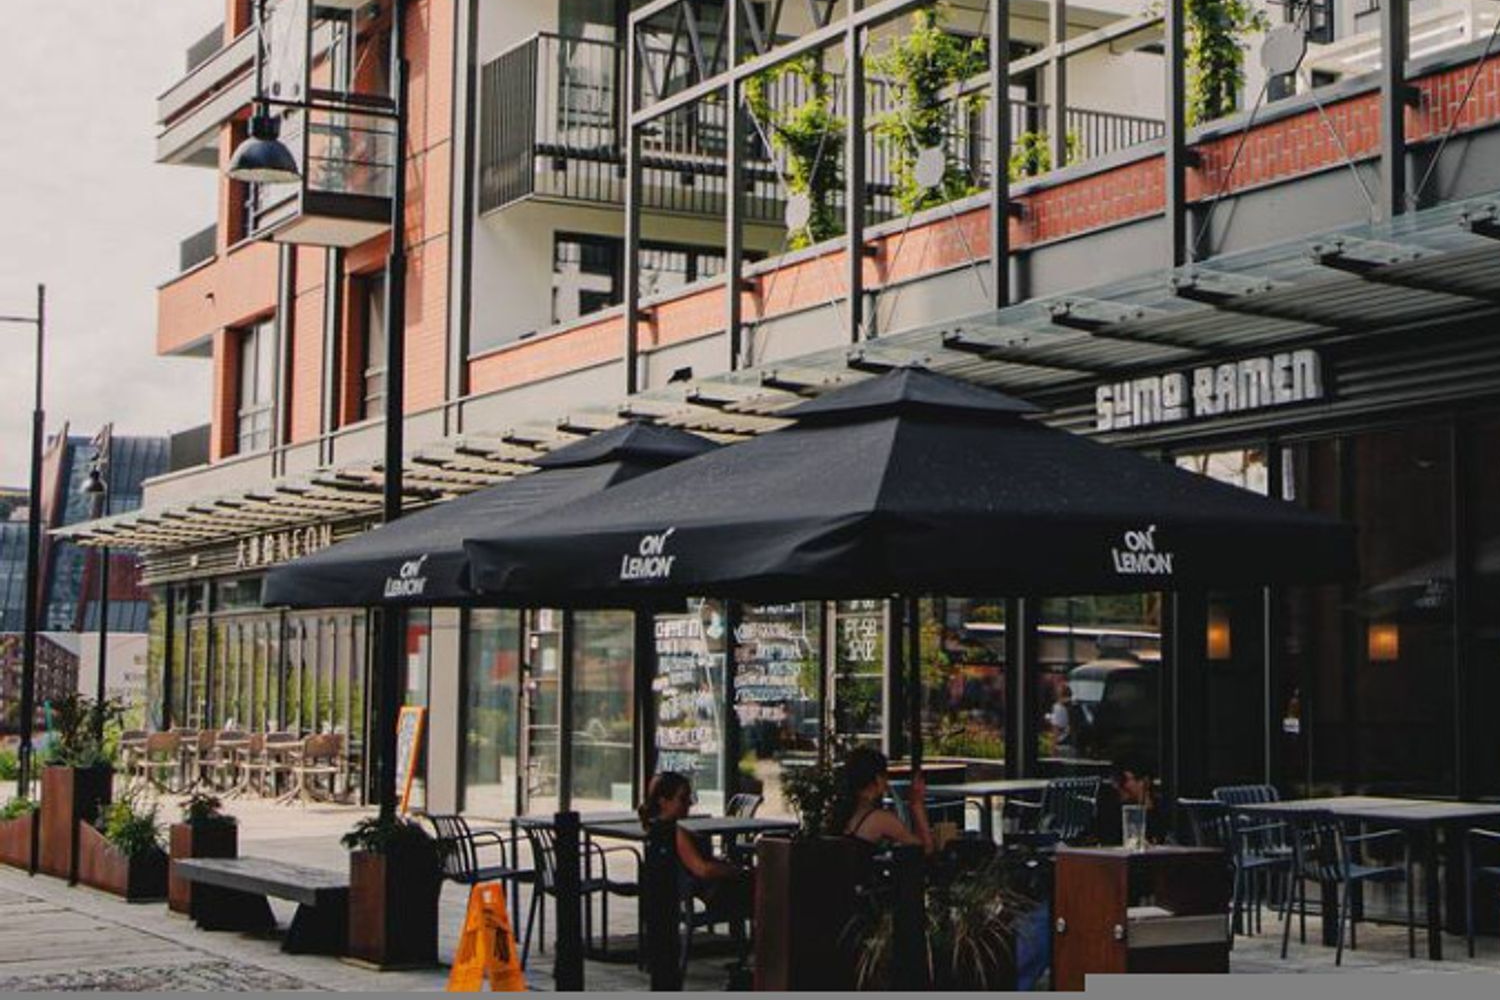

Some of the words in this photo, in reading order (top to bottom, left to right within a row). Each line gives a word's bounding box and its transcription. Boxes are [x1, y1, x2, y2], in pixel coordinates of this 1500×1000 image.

[1096, 373, 1188, 432] SUMO
[1193, 349, 1323, 417] RAMEN
[279, 524, 331, 562] NEON
[639, 529, 670, 556] ON
[1125, 527, 1155, 550] ON
[400, 556, 426, 578] ON
[620, 554, 676, 579] LEMON
[1112, 548, 1173, 574] LEMON
[384, 577, 427, 598] LEMON
